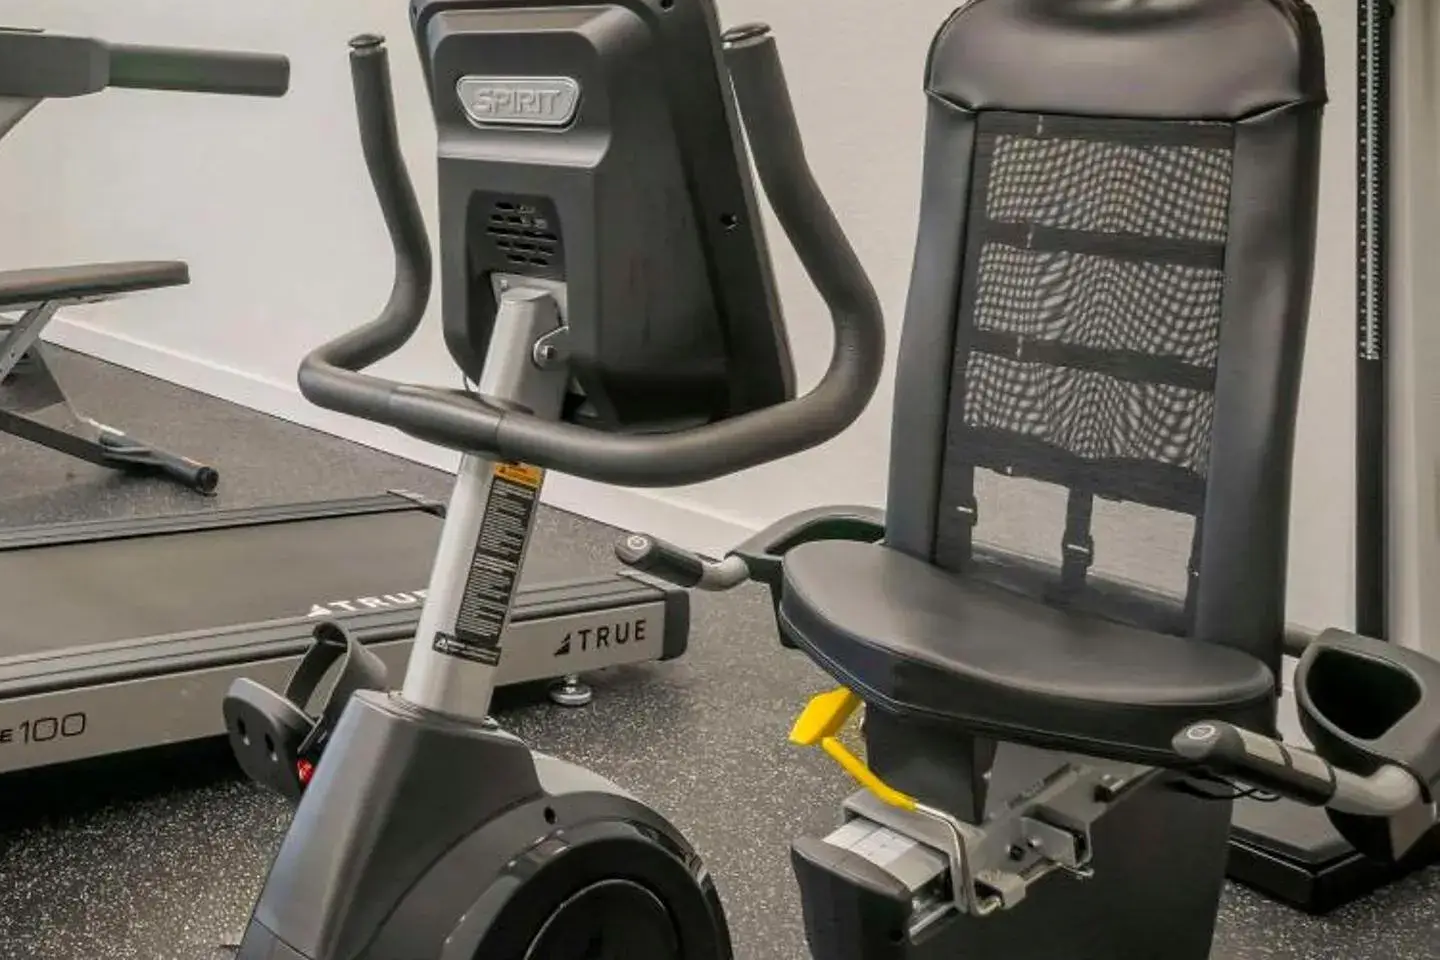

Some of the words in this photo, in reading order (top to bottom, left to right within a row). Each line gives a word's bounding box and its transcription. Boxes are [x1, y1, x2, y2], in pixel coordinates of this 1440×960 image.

[471, 87, 561, 115] SPIRIT
[577, 618, 647, 651] TRUE
[18, 711, 87, 745] 100
